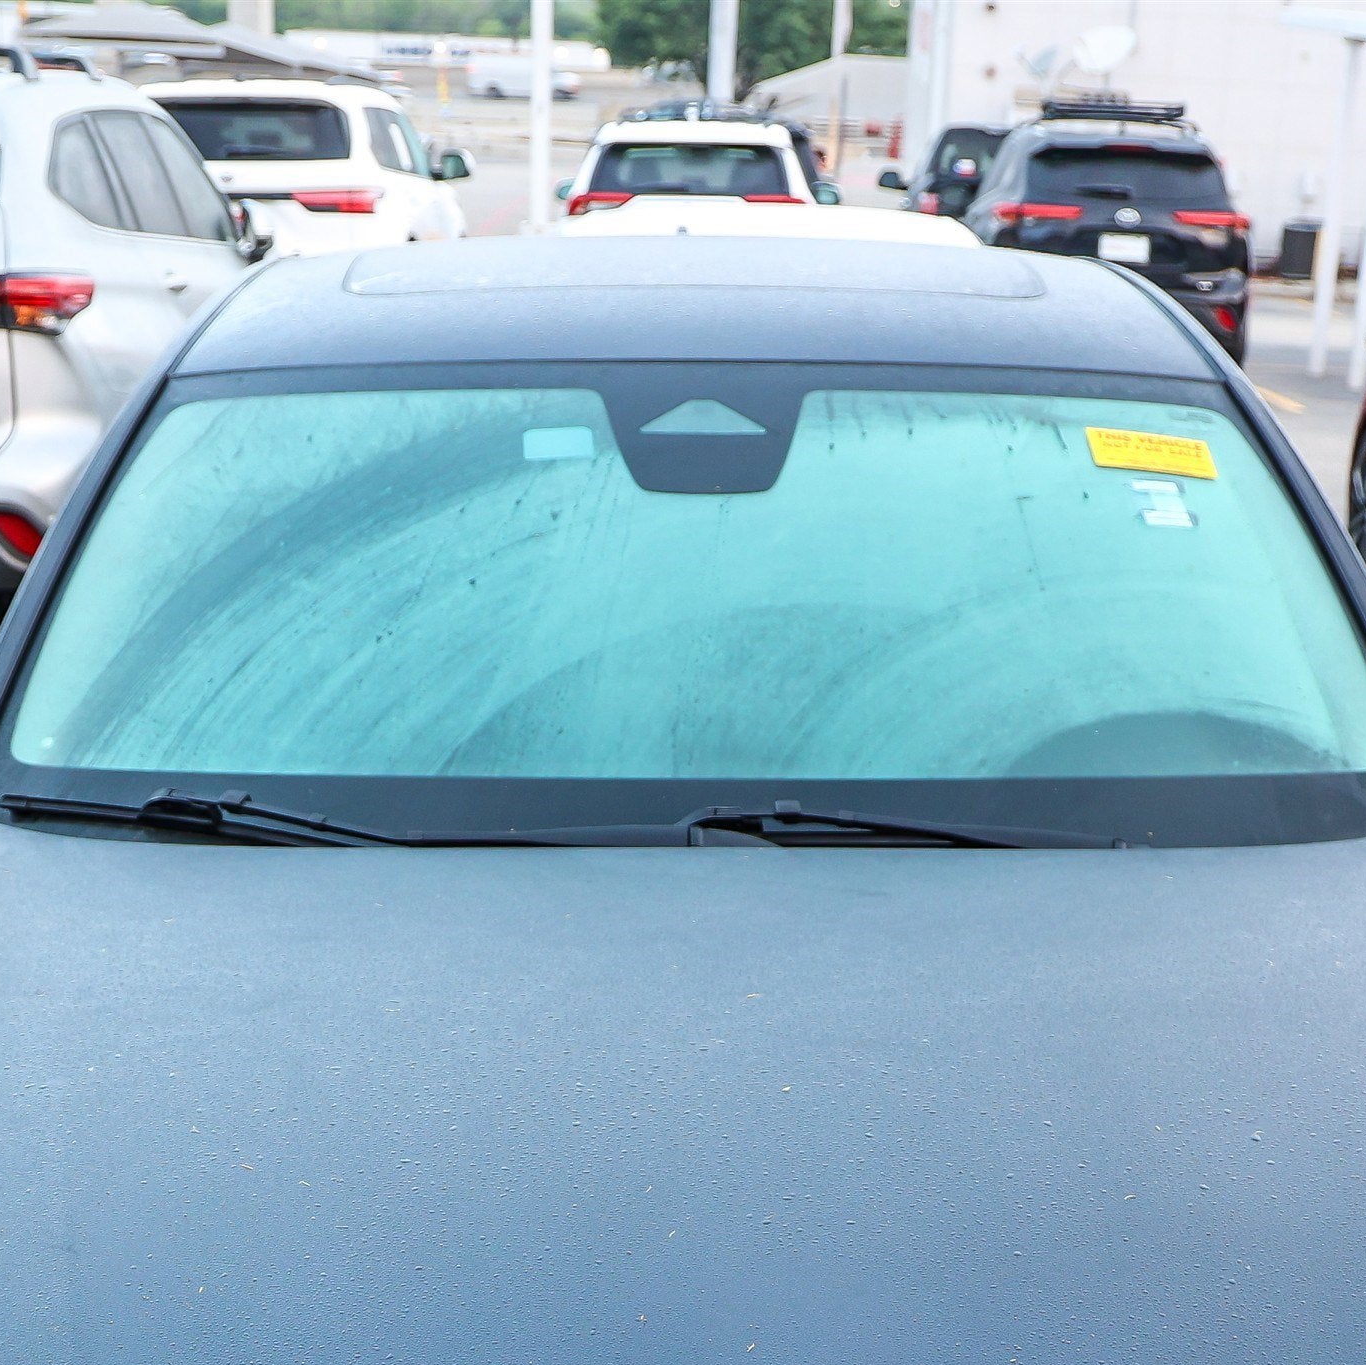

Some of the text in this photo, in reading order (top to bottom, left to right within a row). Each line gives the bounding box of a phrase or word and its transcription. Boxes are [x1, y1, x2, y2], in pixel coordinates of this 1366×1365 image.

[1097, 432, 1203, 451] THIS VEHICLE
[1102, 441, 1203, 458] NOT FOR SALE
